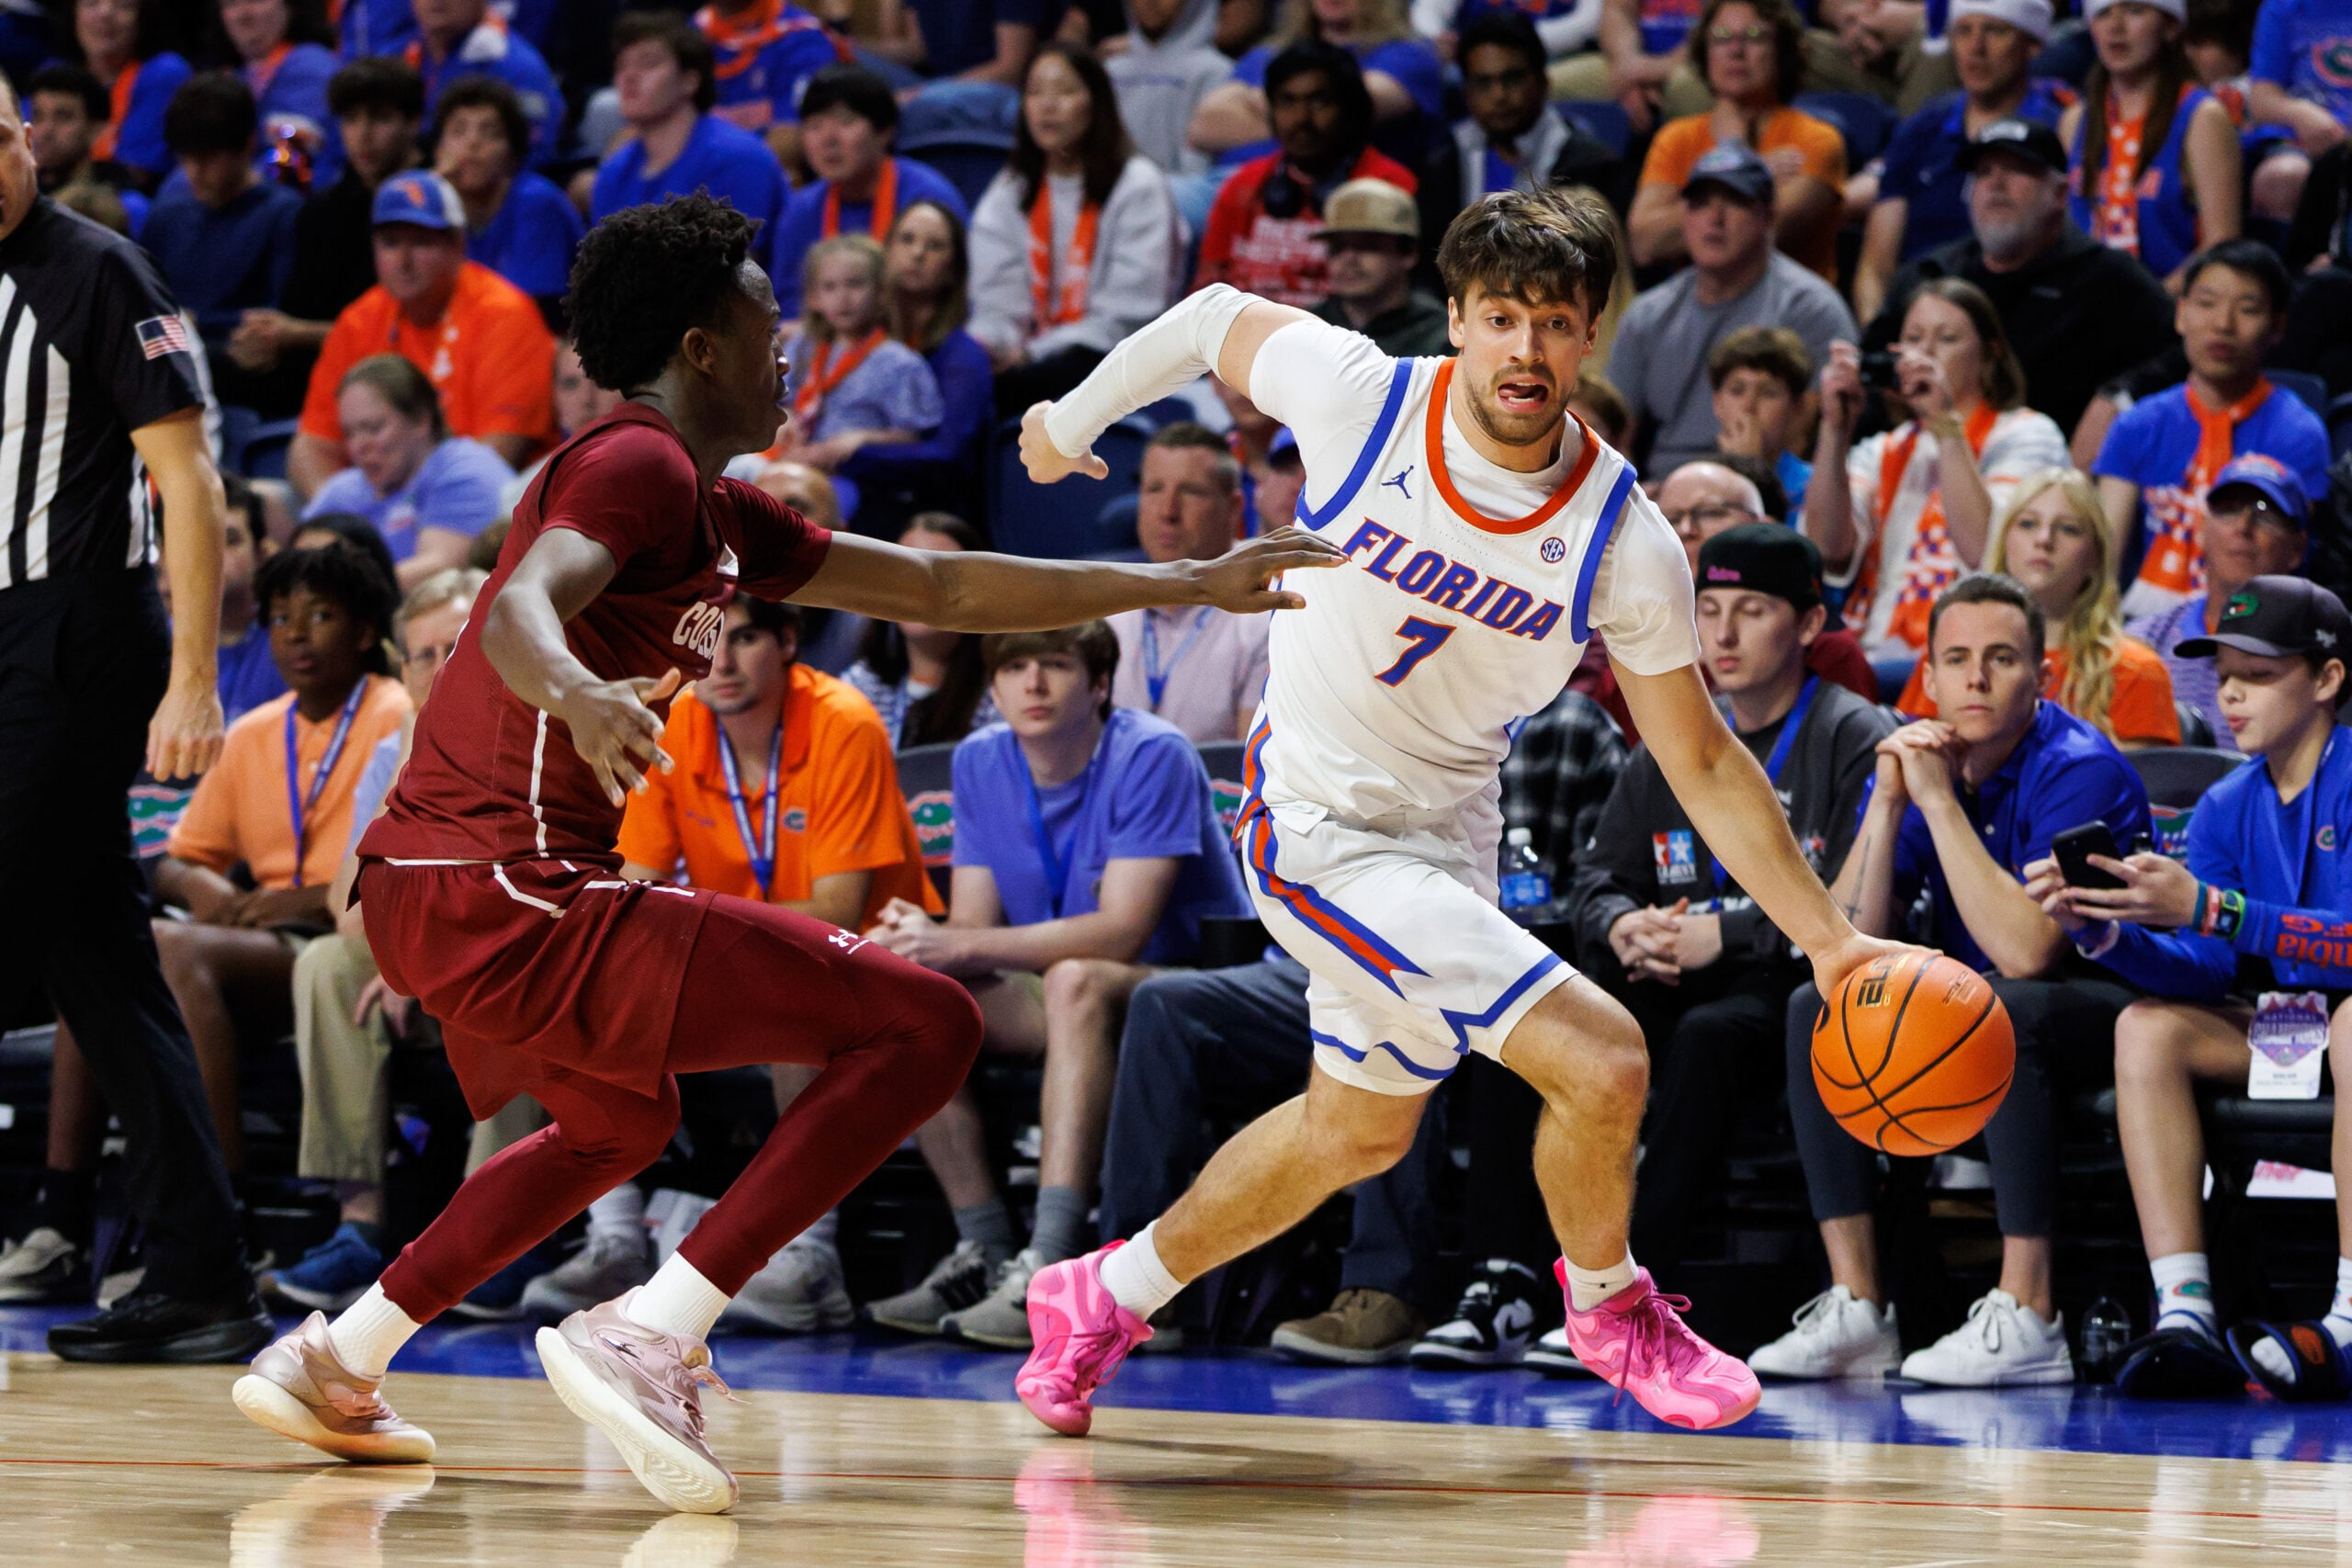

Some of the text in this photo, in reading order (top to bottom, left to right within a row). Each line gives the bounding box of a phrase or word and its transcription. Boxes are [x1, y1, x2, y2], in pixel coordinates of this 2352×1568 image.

[1341, 516, 1565, 641] FLORIDA
[1542, 538, 1564, 562] SEC
[1374, 615, 1457, 688] 7
